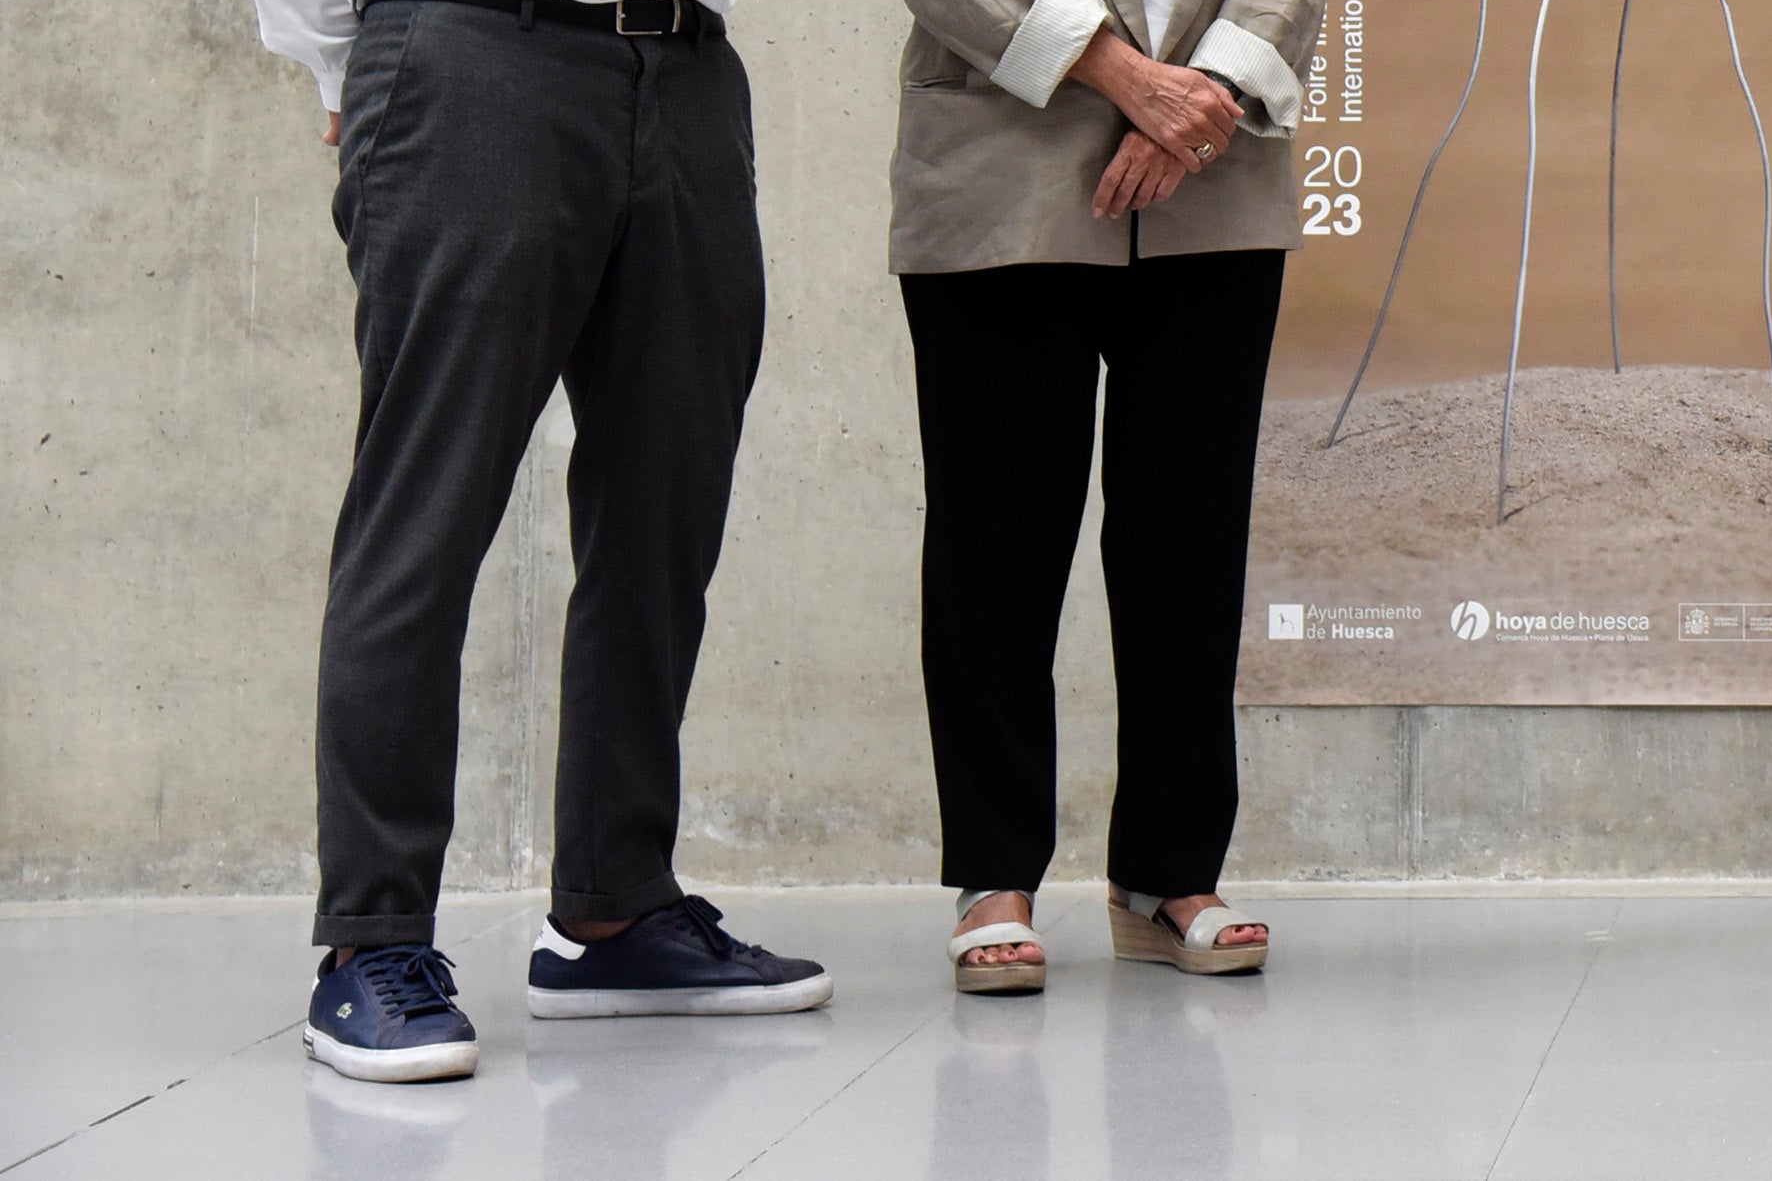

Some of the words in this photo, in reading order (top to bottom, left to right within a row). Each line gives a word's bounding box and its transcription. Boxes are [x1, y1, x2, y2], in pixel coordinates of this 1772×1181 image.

[1303, 145, 1362, 188] 20
[1302, 193, 1362, 236] 23
[1306, 604, 1422, 623] Ayuntamiento
[1496, 611, 1547, 634] hoya
[1550, 611, 1575, 630] de
[1578, 611, 1649, 630] huesca
[1306, 624, 1326, 639] de
[1331, 623, 1394, 639] Huesca
